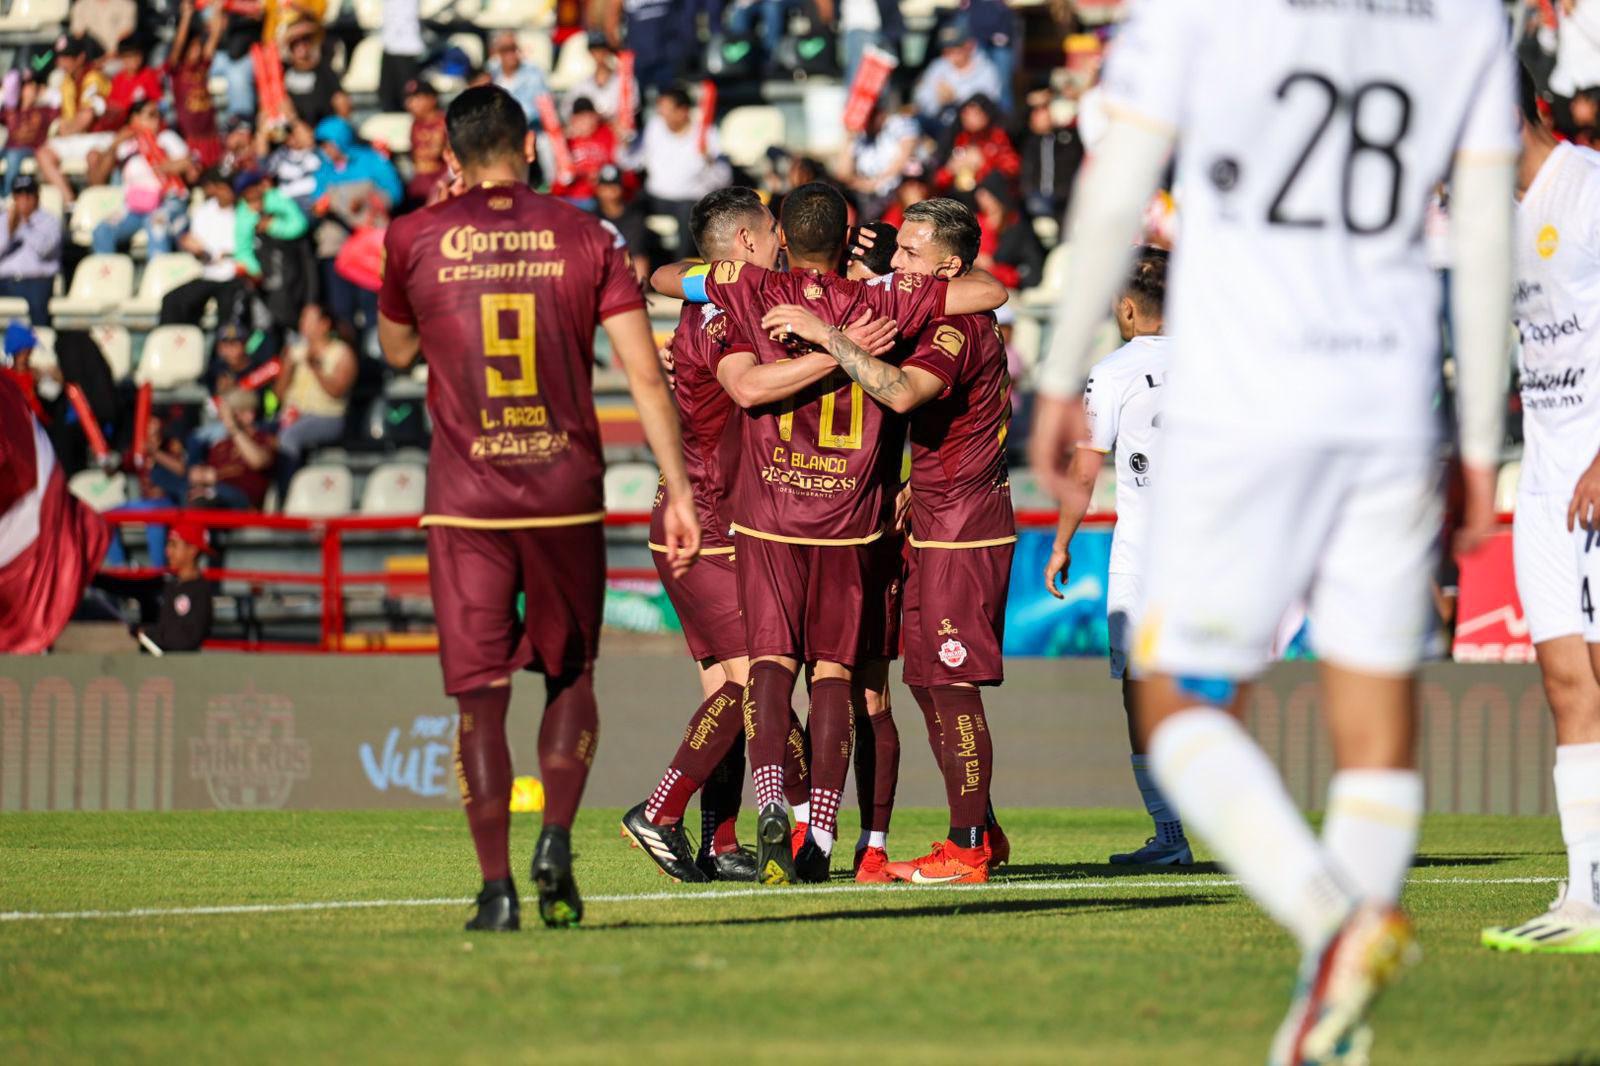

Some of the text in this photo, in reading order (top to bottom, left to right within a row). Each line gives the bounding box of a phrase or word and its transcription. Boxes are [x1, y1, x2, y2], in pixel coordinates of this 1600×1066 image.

[1266, 71, 1414, 236] 28
[440, 224, 557, 262] Corona
[438, 258, 566, 283] cesantoni
[481, 292, 538, 398] 9
[481, 406, 547, 429] L. RAZO
[773, 446, 848, 474] C. BLANCO
[762, 466, 856, 493] ZACATECAS
[689, 693, 736, 751] Tierra Adentro
[955, 714, 980, 797] Tierra Adentro
